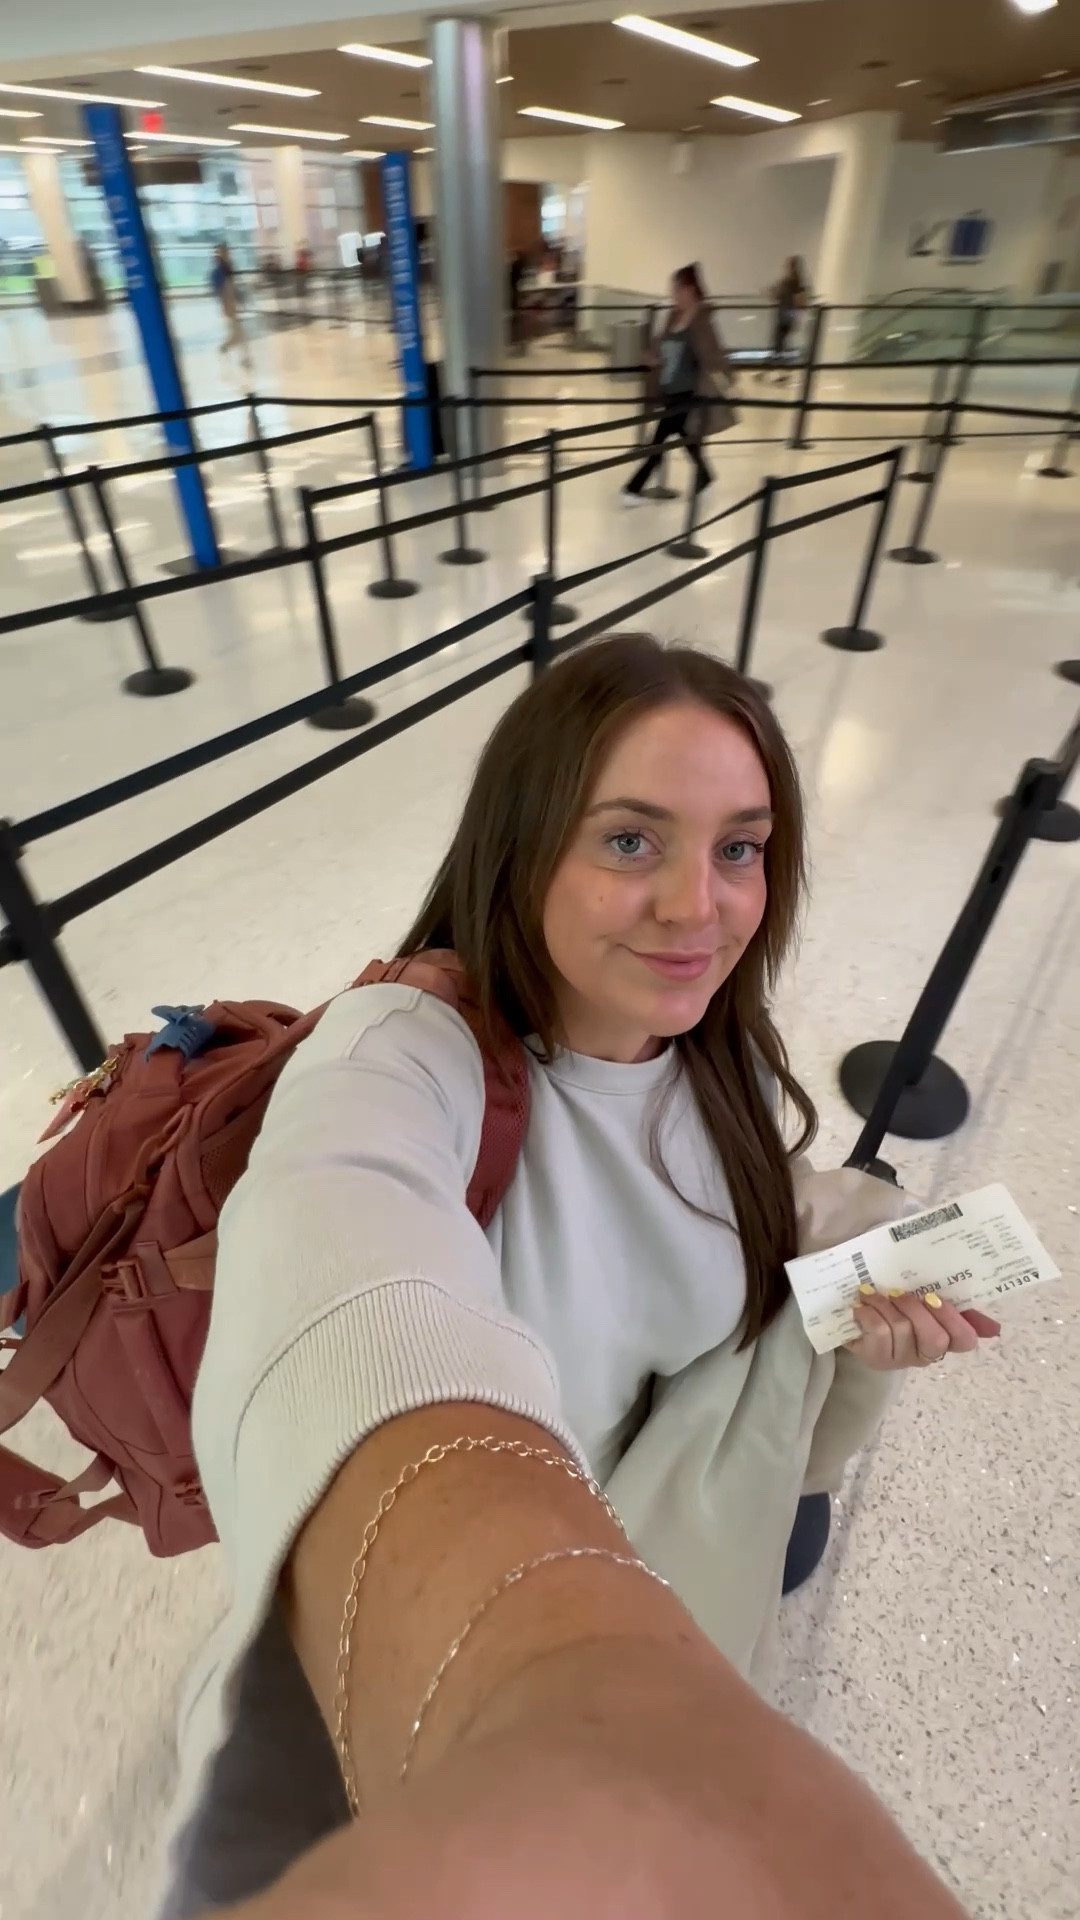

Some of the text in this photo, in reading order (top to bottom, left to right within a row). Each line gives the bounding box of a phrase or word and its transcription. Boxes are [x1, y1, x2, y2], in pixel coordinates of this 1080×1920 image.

[946, 1269, 973, 1286] SEAT
[995, 1275, 1031, 1293] DELTA
[910, 1281, 941, 1297] REQU
